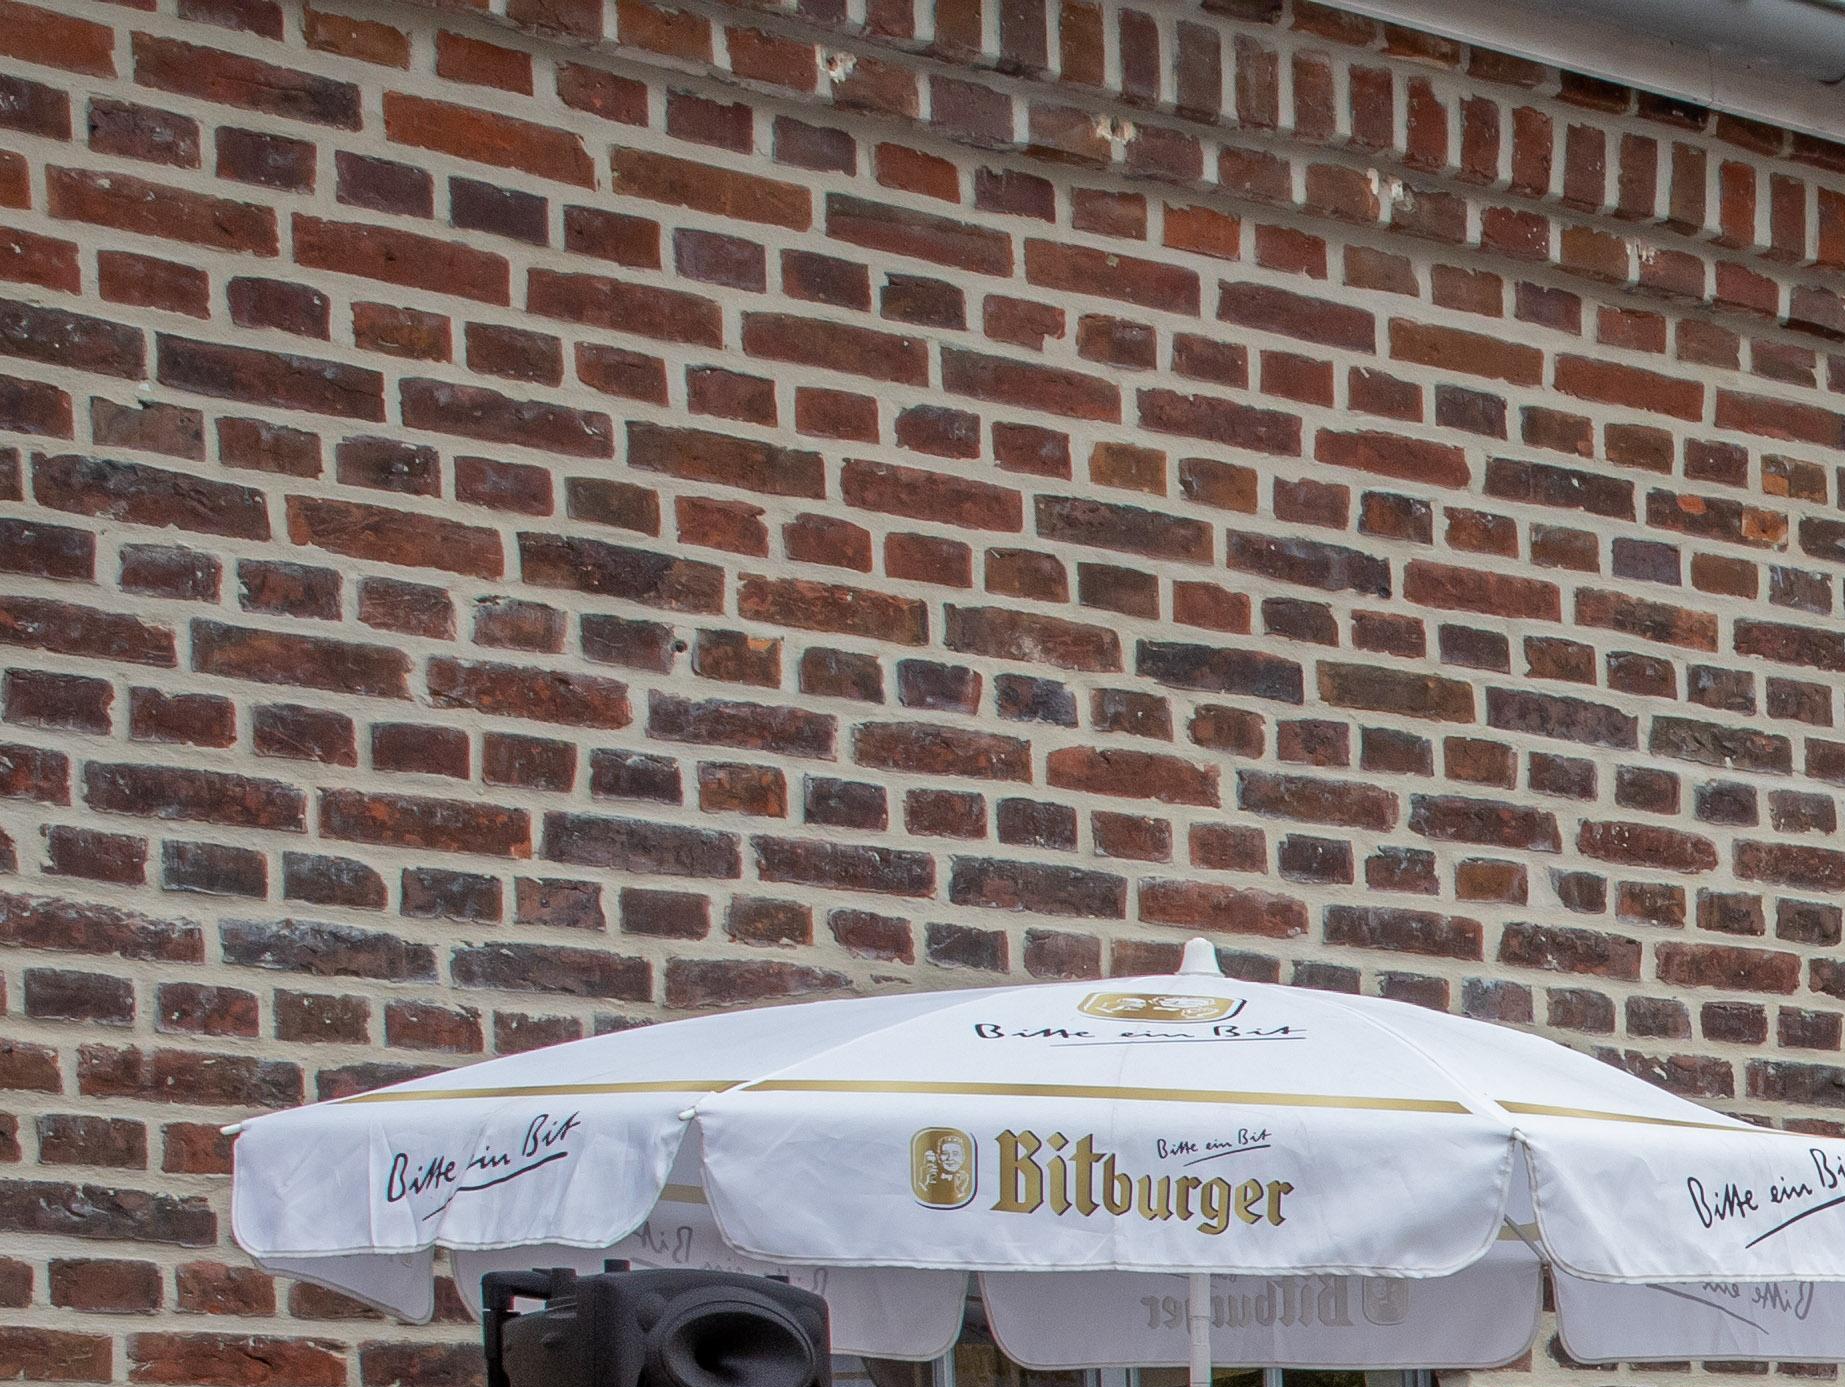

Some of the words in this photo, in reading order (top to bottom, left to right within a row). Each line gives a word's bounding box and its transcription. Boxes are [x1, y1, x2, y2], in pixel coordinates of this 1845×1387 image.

[975, 1023, 1095, 1039] Bitte
[1121, 1029, 1194, 1038] ein
[1213, 1024, 1306, 1038] Bit
[388, 1153, 456, 1202] Bitte
[467, 1146, 510, 1169] in
[522, 1111, 581, 1157] Bit
[1157, 1139, 1198, 1160] Bitte
[1206, 1138, 1232, 1152] ein
[1238, 1129, 1271, 1145] Bit
[990, 1129, 1294, 1235] Bitburger
[1687, 1177, 1758, 1228] Bitte
[1771, 1176, 1812, 1203] ein
